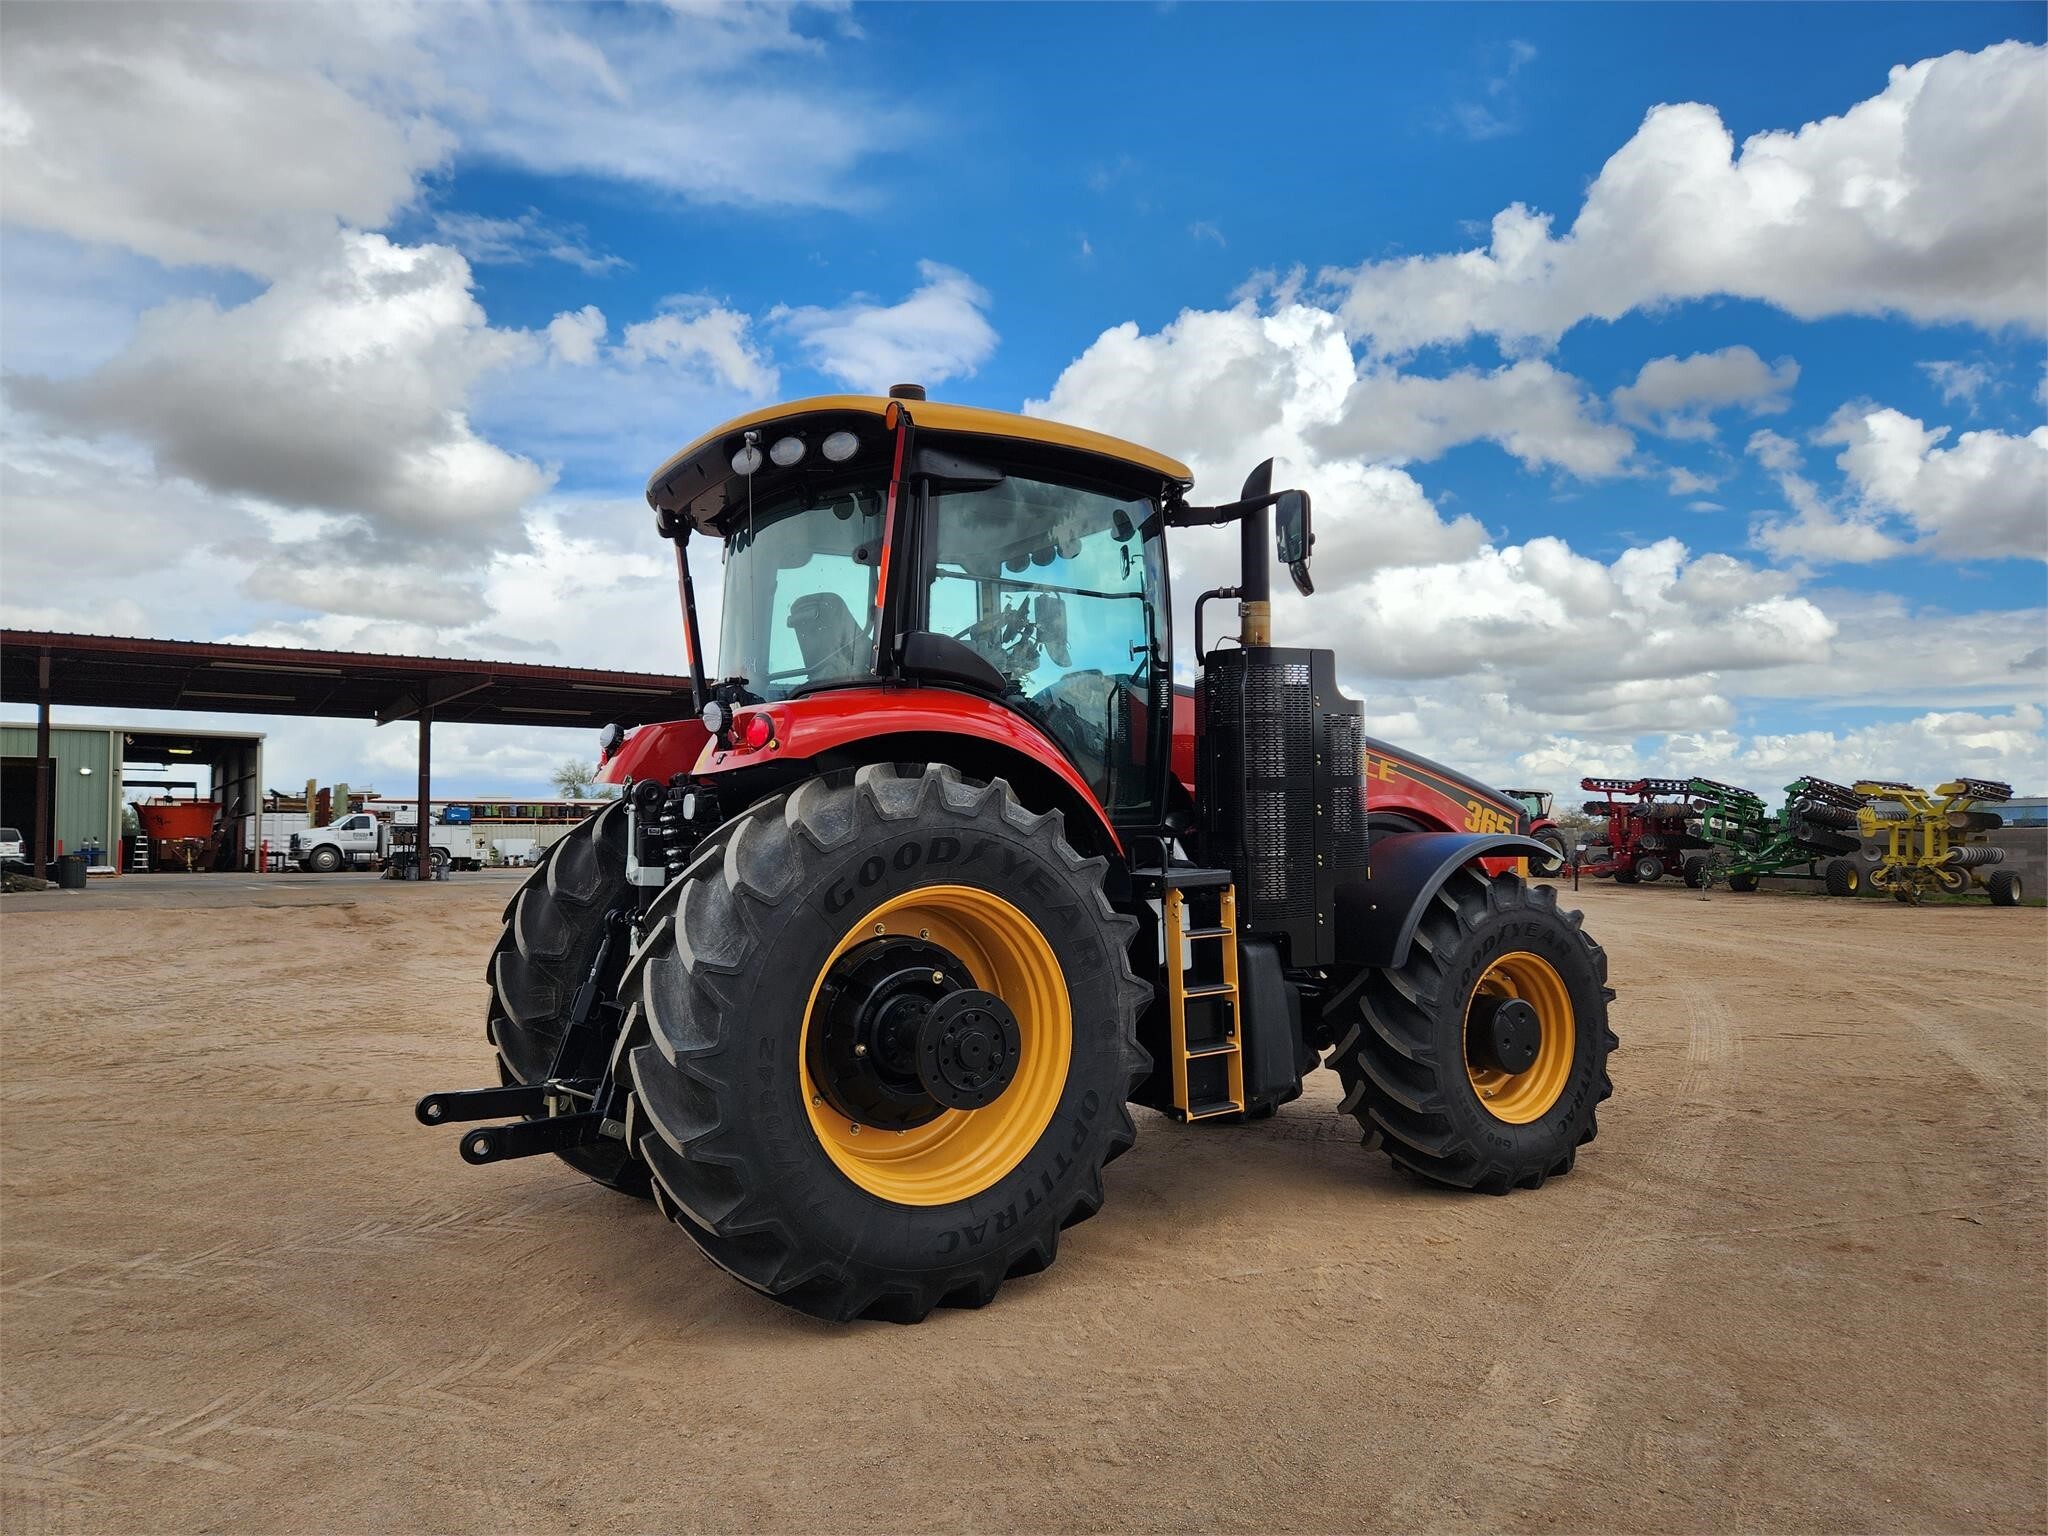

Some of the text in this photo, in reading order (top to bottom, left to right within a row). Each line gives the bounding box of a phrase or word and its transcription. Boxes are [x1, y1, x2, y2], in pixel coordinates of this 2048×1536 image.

[1465, 800, 1513, 835] 365
[823, 836, 1106, 976] GOODYEAR
[1453, 921, 1572, 1009] GOODYEAR
[936, 1089, 1100, 1255] OPTITRAC
